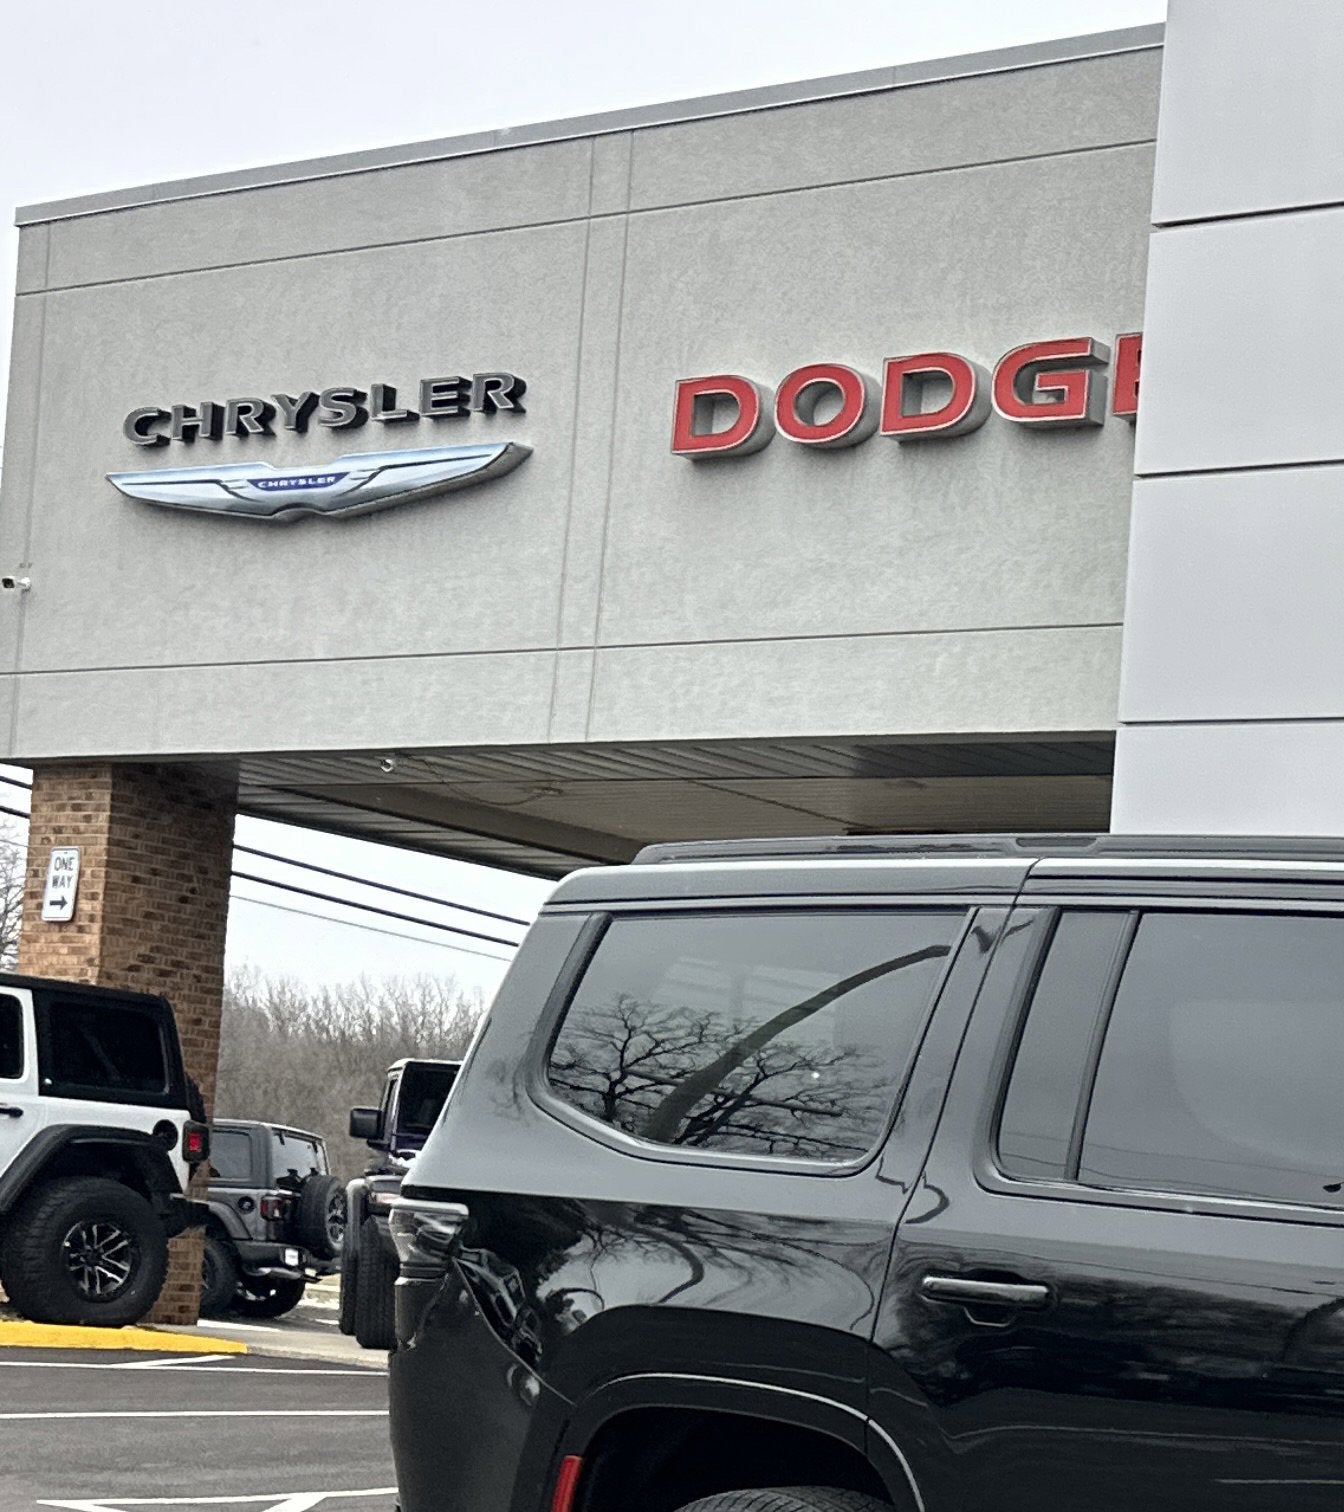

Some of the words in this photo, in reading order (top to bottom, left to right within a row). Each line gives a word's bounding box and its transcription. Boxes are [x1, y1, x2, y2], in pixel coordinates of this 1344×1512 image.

[123, 372, 525, 446] CHRYSLER
[257, 476, 336, 489] CHRYSLER
[54, 856, 75, 872] ONE
[51, 875, 73, 889] WAY
